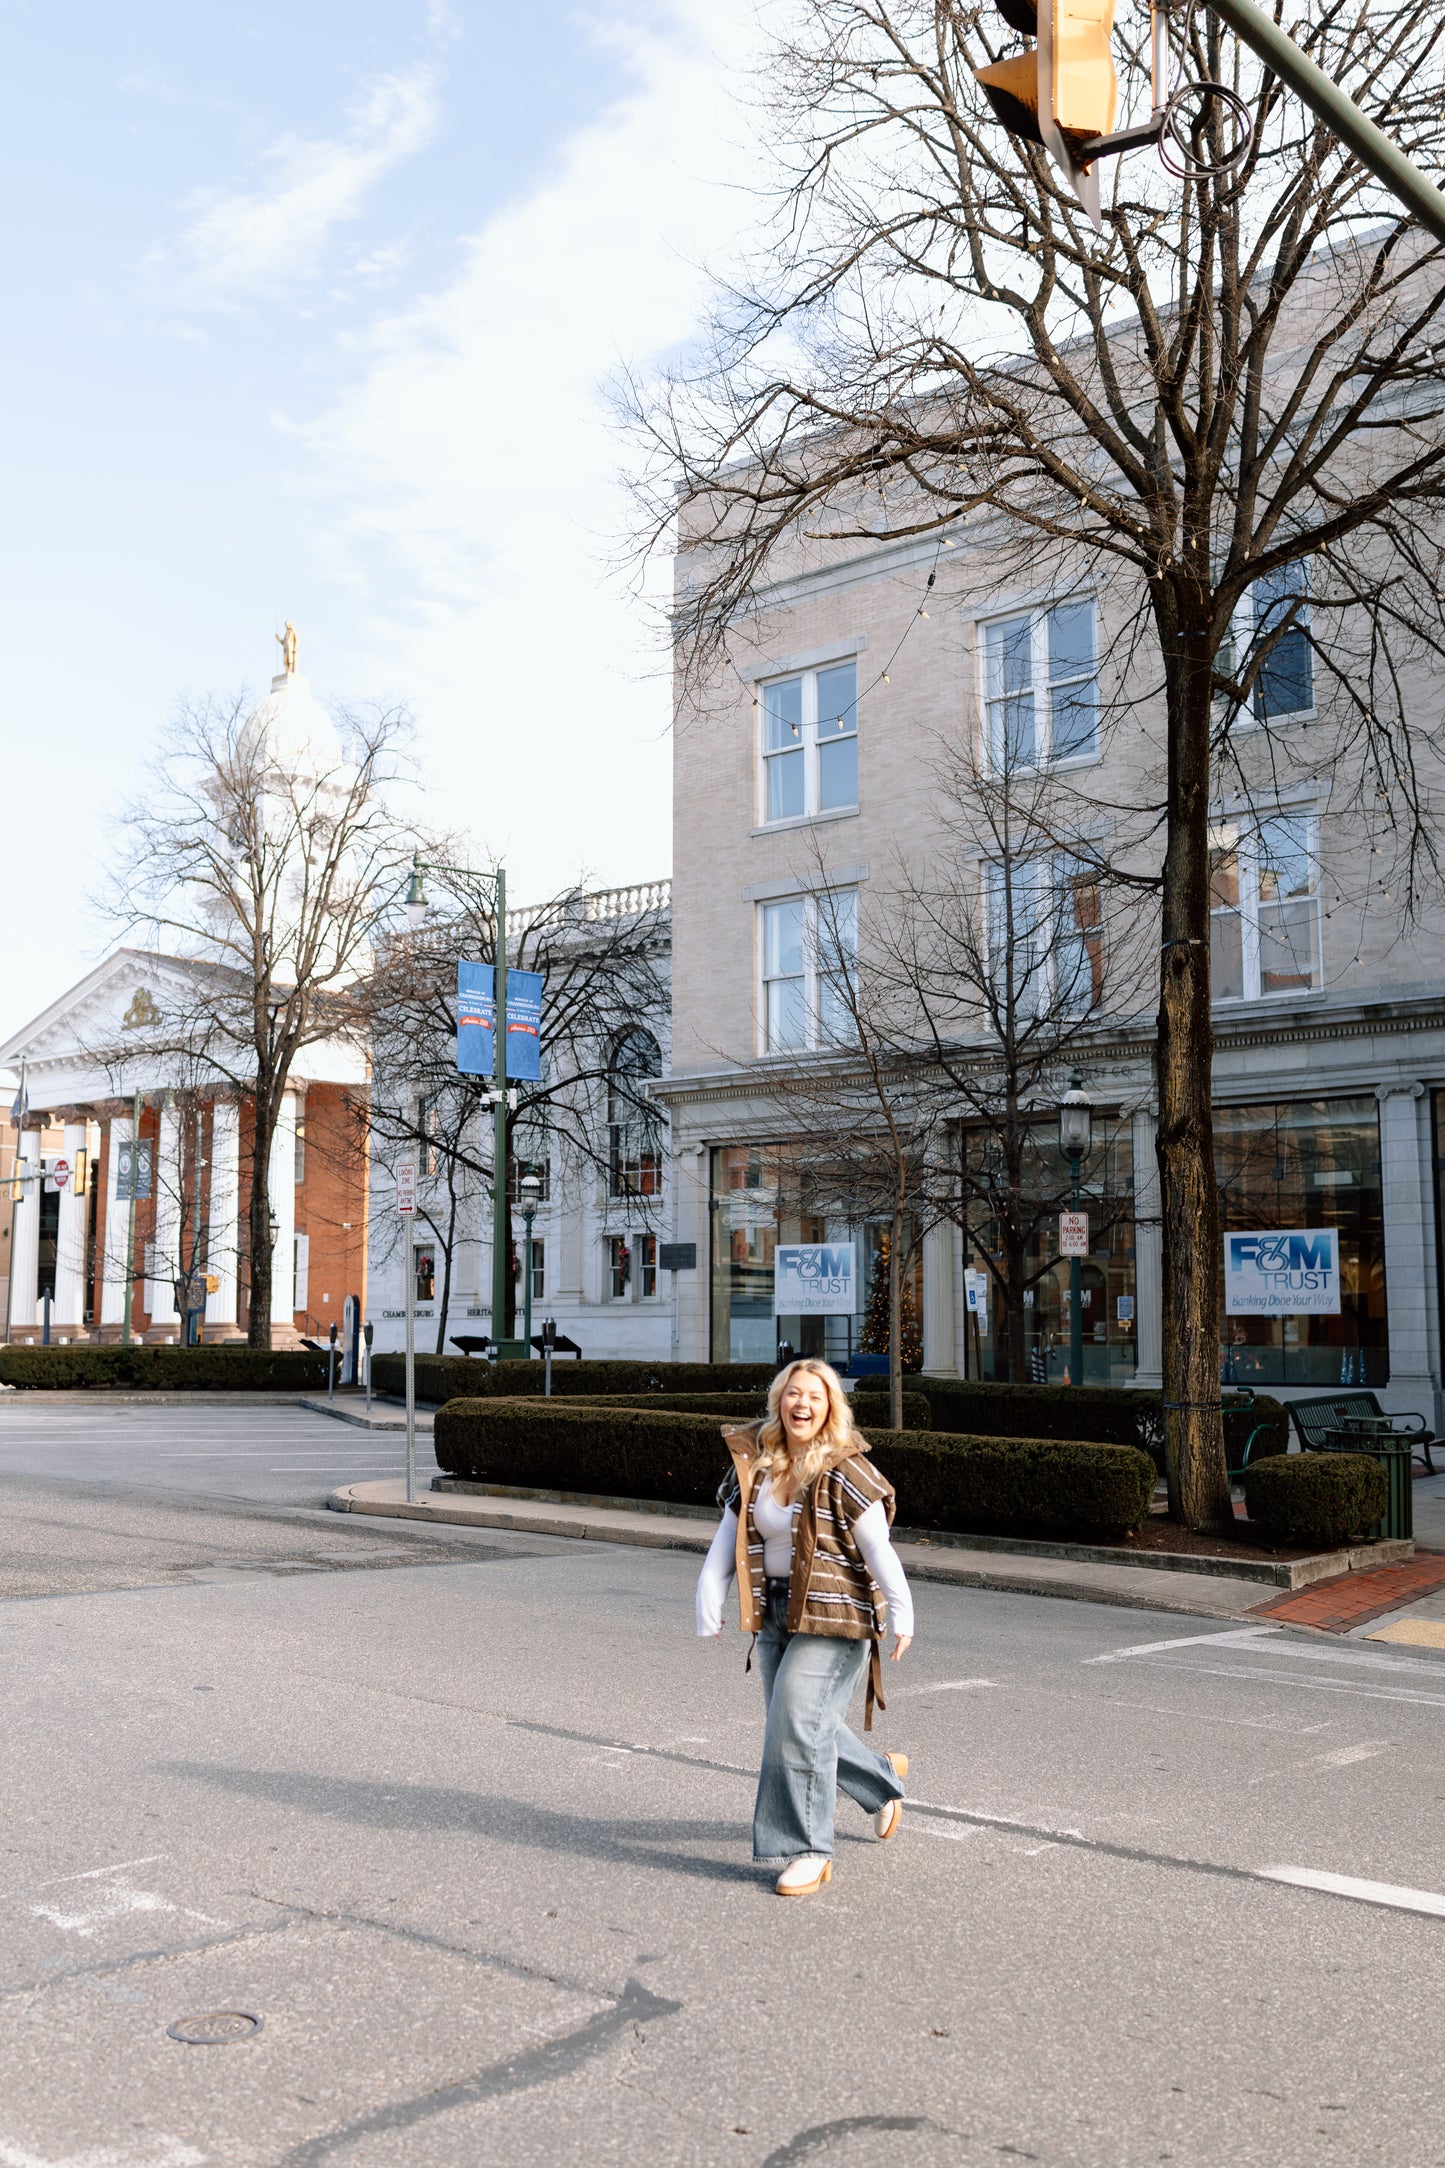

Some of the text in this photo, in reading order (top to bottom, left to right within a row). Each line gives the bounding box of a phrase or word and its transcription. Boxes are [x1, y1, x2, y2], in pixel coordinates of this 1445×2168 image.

[459, 1005, 492, 1016] CELEBRATE
[507, 1013, 540, 1024] CELEBRATE
[1068, 1217, 1080, 1225] NO
[1062, 1226, 1086, 1234] PARKING
[1230, 1235, 1332, 1272] F&M
[779, 1248, 851, 1279] F&M
[800, 1278, 851, 1294] TRUST
[1258, 1271, 1333, 1290] TRUST
[804, 1297, 821, 1307] Done
[1232, 1293, 1334, 1309] Banking Done Your Way
[382, 1310, 434, 1318] CHAMBSBURG
